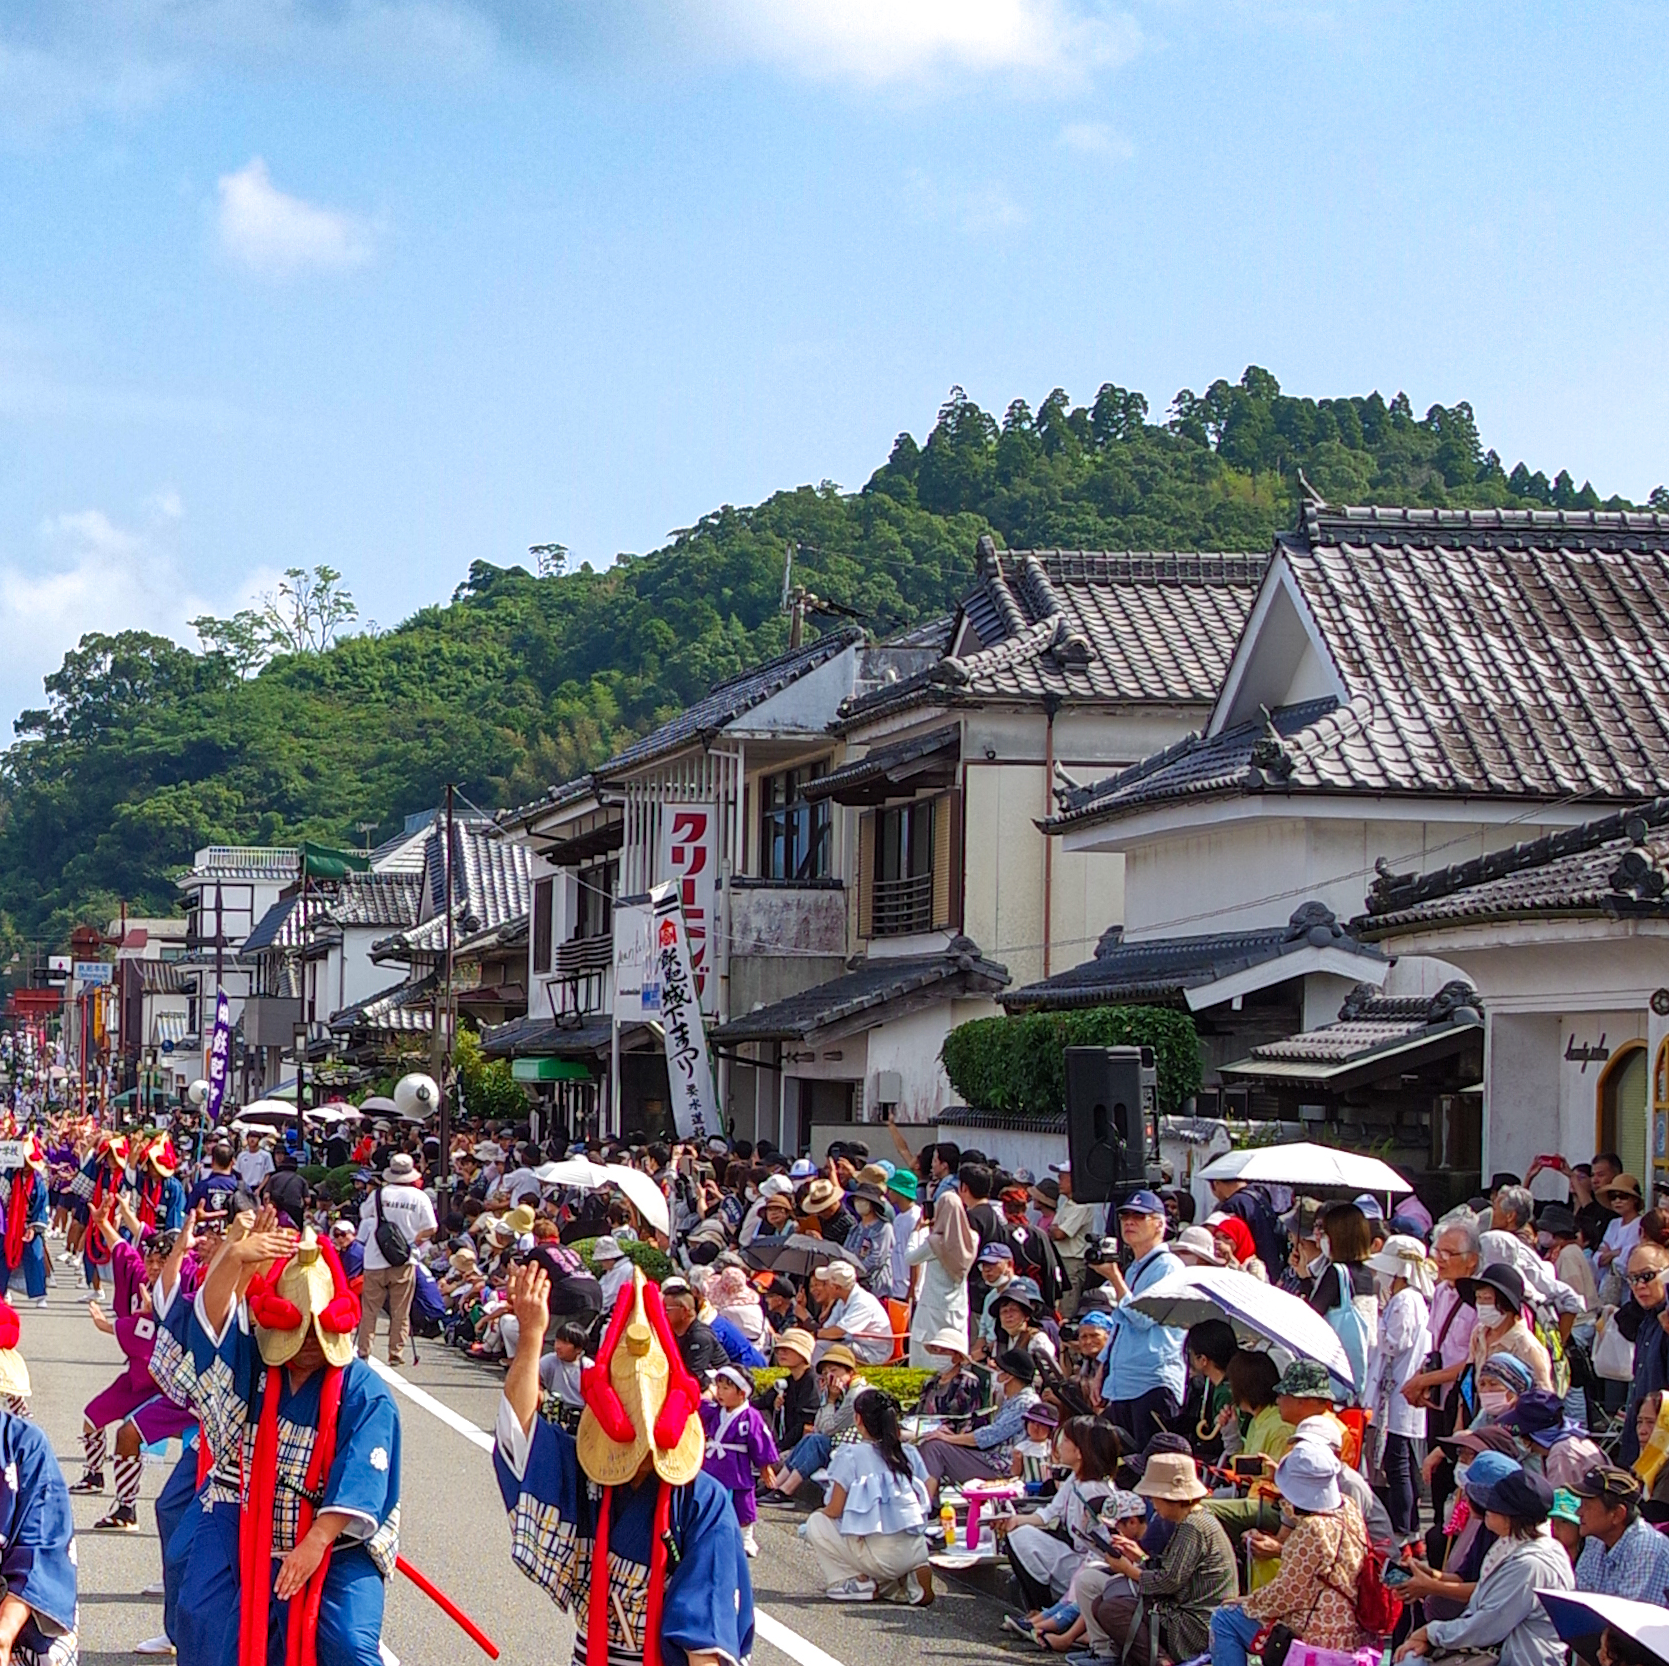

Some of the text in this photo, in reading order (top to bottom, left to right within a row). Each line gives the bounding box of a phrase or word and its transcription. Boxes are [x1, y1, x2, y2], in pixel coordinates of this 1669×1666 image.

[656, 947, 700, 1079] 飫肥城下まつり
